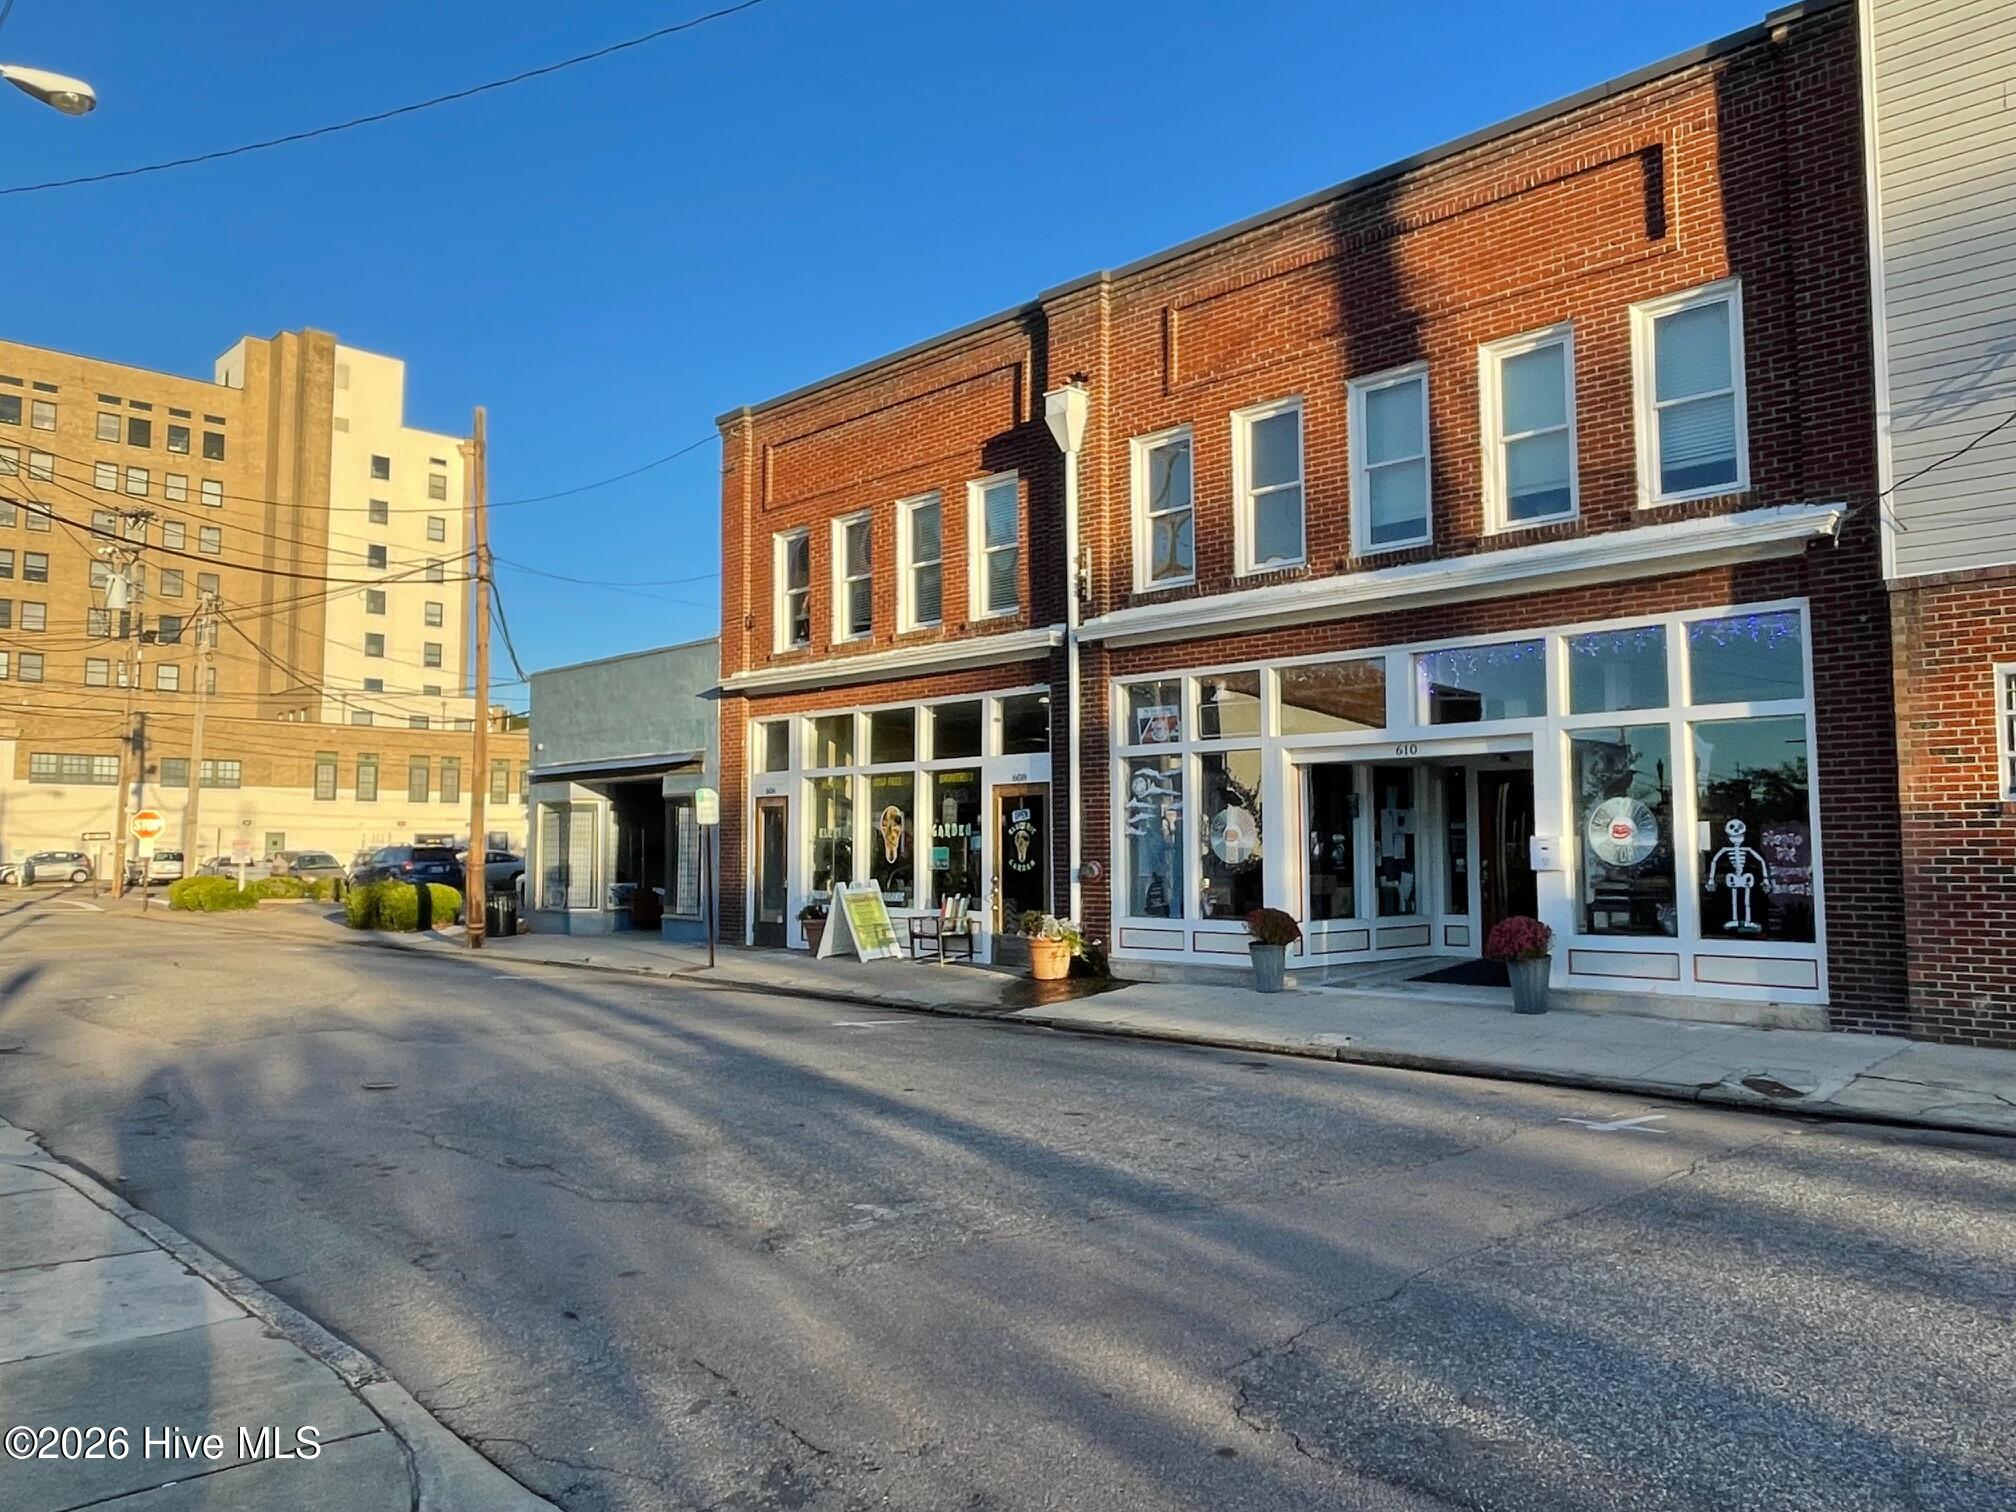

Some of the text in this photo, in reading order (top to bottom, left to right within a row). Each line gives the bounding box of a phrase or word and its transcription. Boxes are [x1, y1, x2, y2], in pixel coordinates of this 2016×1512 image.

[1396, 744, 1417, 756] 610
[1012, 773, 1028, 782] 608
[1013, 810, 1029, 821] OPEN
[134, 818, 162, 832] STOP
